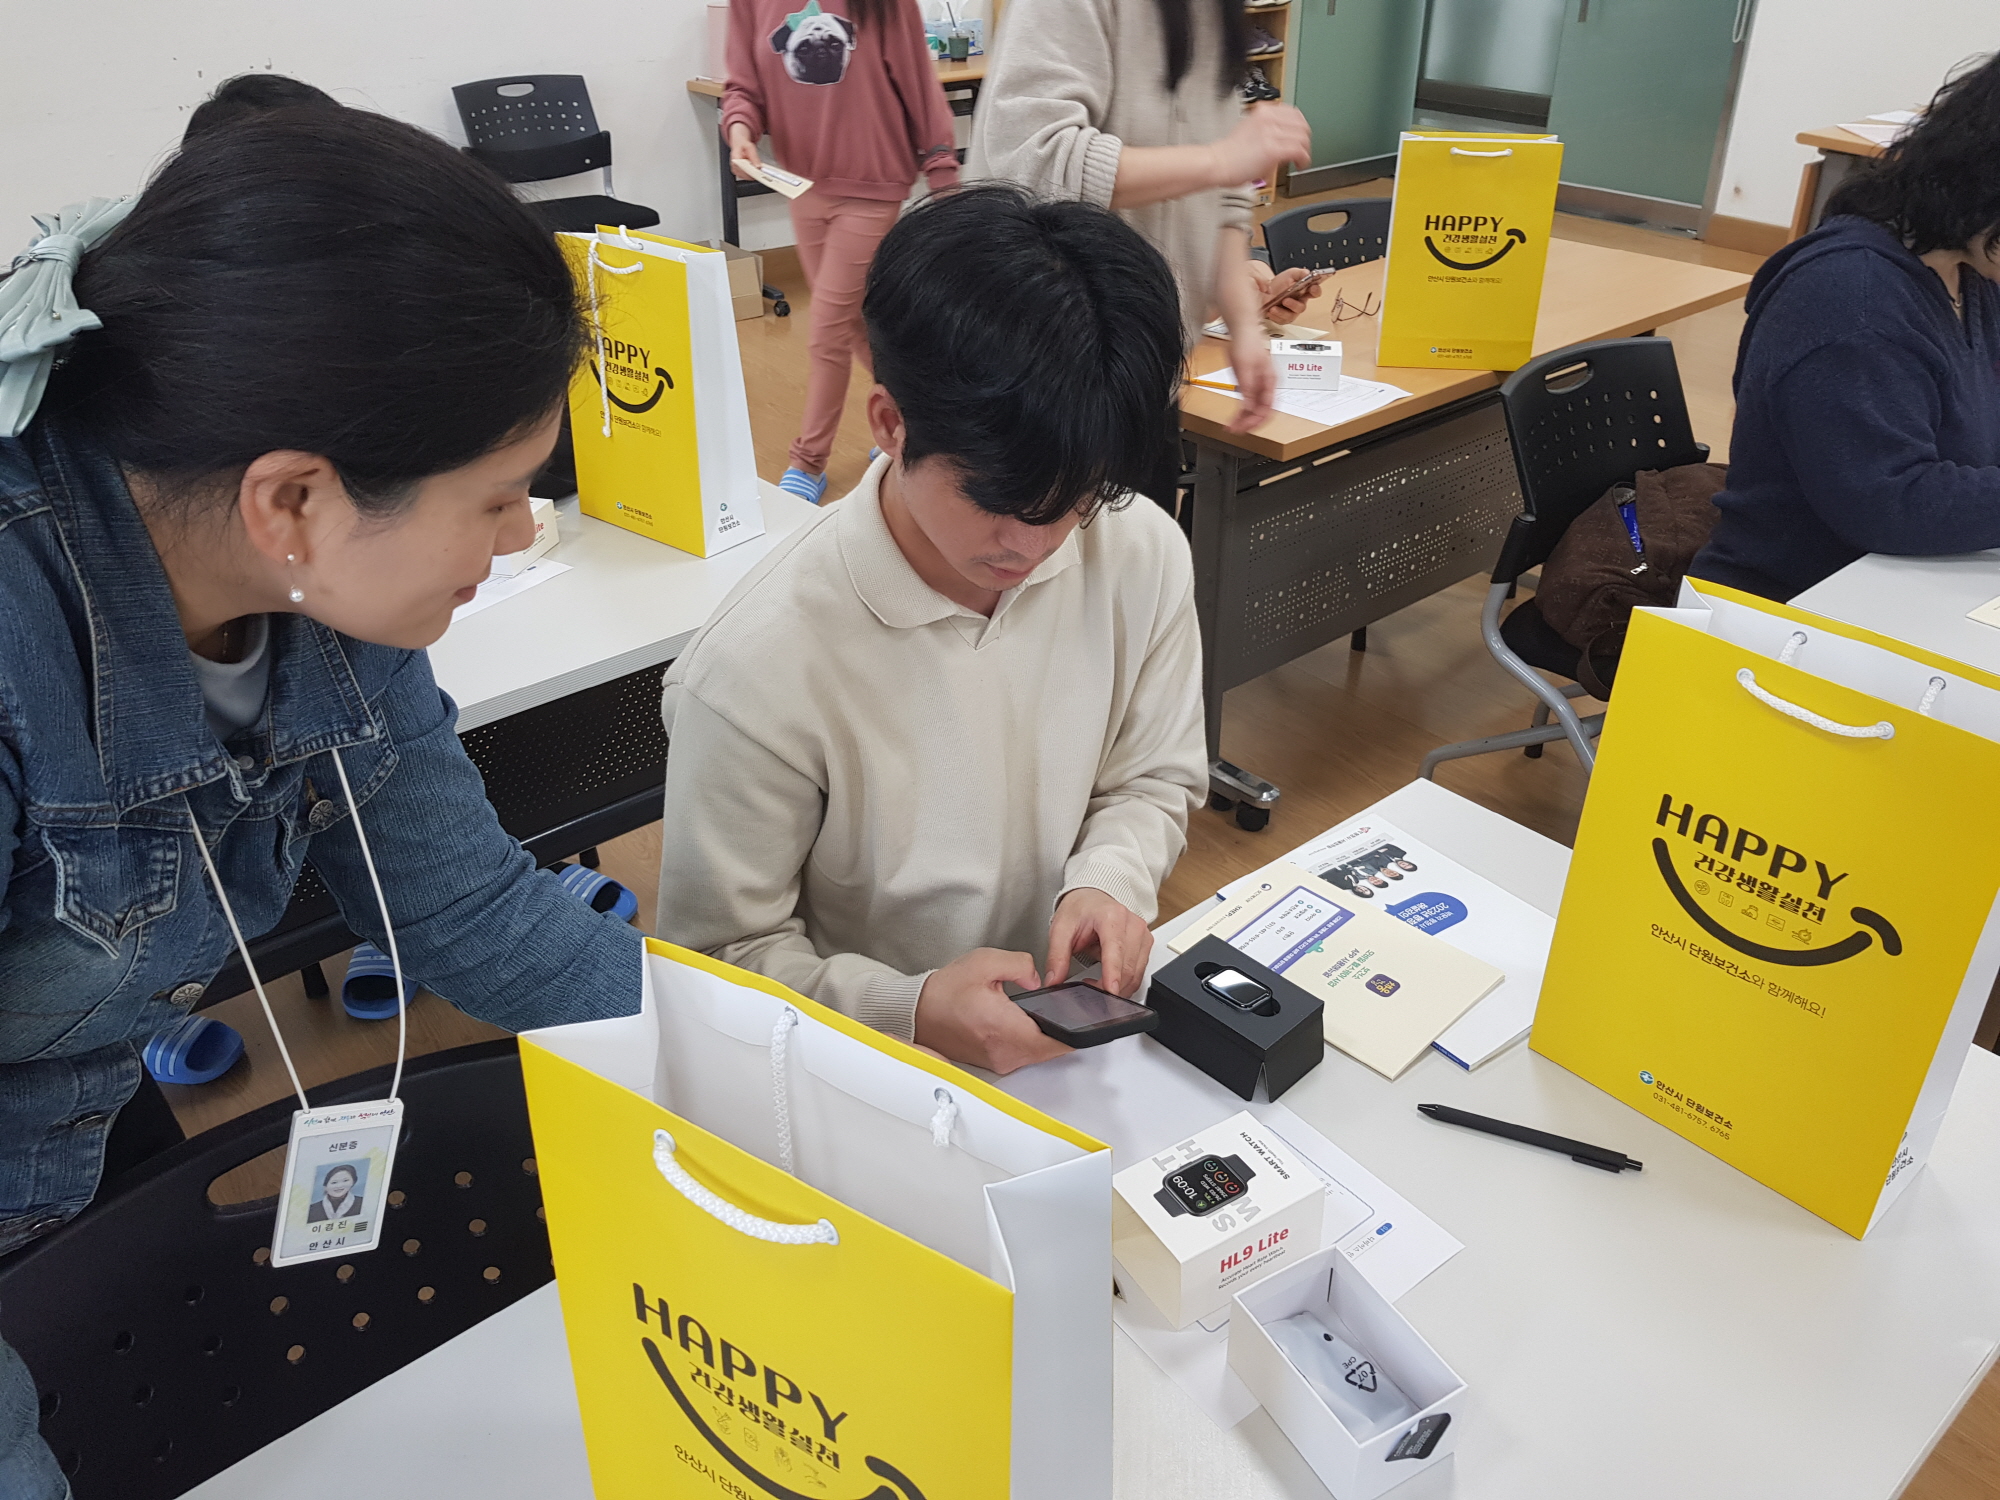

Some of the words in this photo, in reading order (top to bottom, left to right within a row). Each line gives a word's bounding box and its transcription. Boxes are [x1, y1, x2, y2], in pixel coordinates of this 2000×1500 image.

[1425, 215, 1504, 232] HAPPY
[1443, 234, 1497, 244] 건강생활실천
[1288, 363, 1304, 371] HL9
[535, 523, 544, 532] ite
[1655, 794, 1849, 901] HAPPY
[1693, 851, 1826, 925] 건강생활실천
[1348, 948, 1360, 959] APP
[1352, 967, 1370, 981] 보건소
[1651, 923, 1687, 952] 안산시
[1689, 942, 1766, 989] 단원보건소와
[1768, 982, 1826, 1018] 함께해요!
[1655, 1080, 1684, 1103] 안산시
[1686, 1097, 1734, 1129] 단원보건소
[1240, 1131, 1265, 1156] WATCH
[1709, 1123, 1730, 1141] 6765
[328, 1140, 358, 1153] 신분증
[1264, 1156, 1290, 1180] SMART
[1172, 1175, 1198, 1200] 10:09
[1220, 1245, 1253, 1274] HL9
[1258, 1228, 1289, 1252] Lite
[633, 1282, 848, 1444] HAPPY
[1342, 1356, 1356, 1369] CPE
[1358, 1370, 1368, 1382] 07
[687, 1361, 841, 1474] 건강생활실천
[674, 1445, 715, 1483] 안산시
